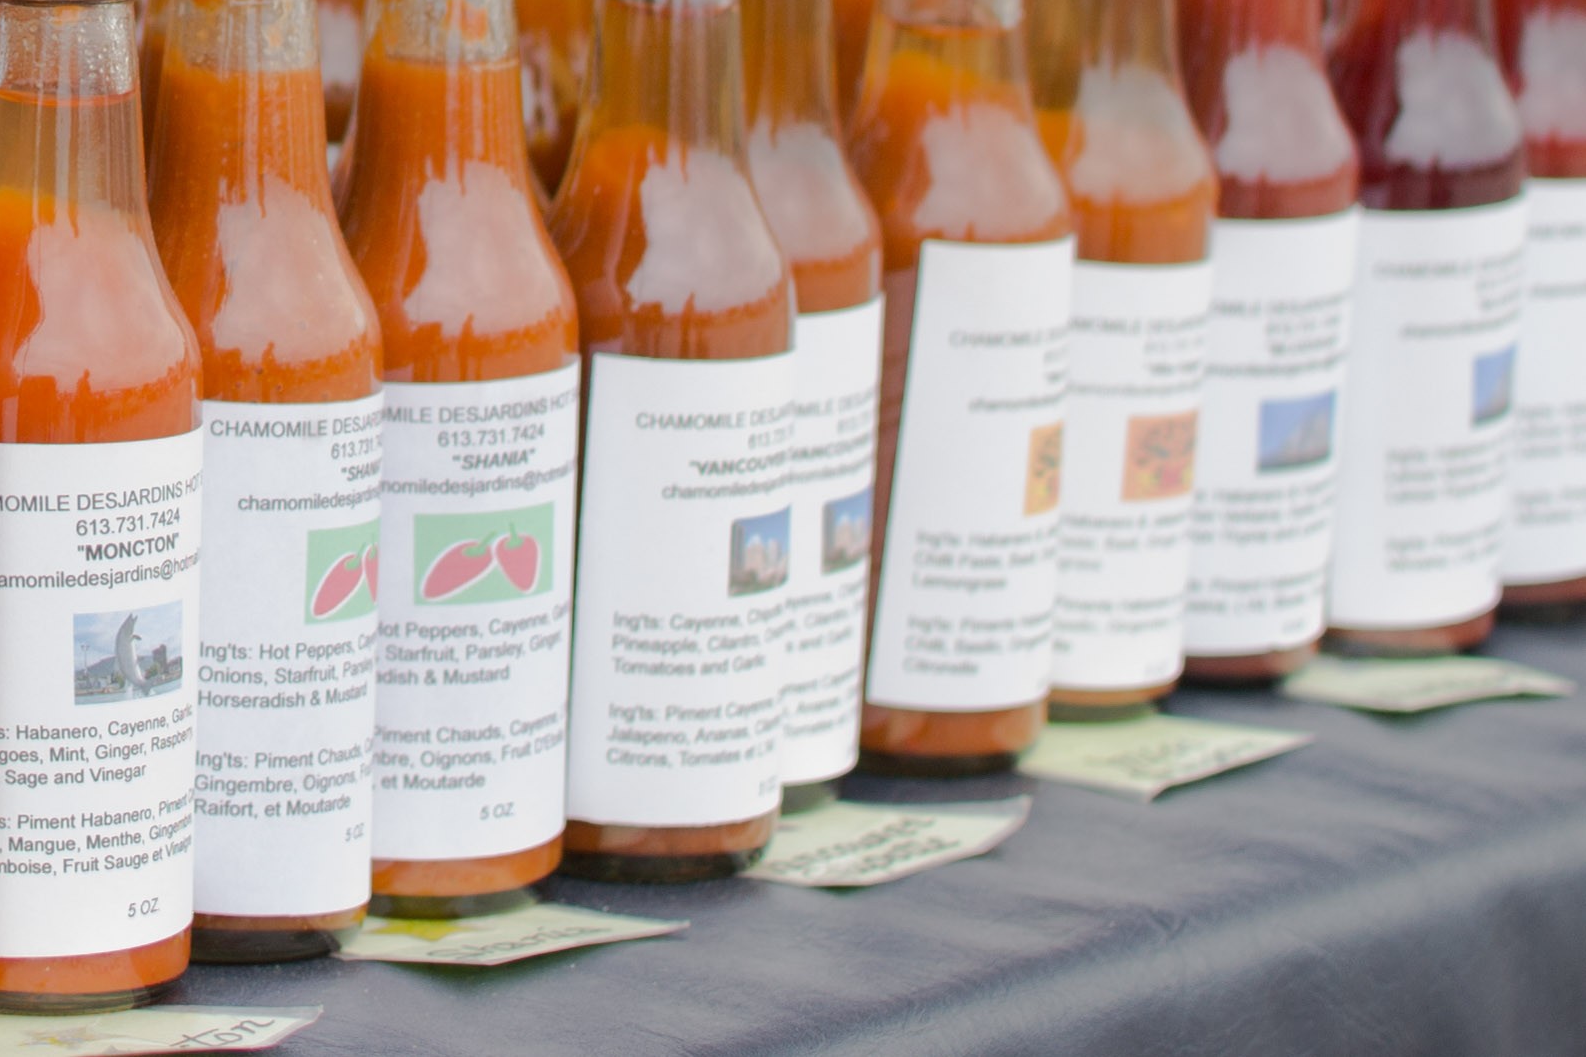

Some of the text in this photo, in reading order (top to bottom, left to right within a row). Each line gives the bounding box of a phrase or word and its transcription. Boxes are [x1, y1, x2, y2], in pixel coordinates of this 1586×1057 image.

[438, 398, 548, 424] DESJARDINS
[635, 411, 745, 432] CHAMOMILE
[210, 419, 328, 438] CHAMOMILE
[437, 423, 545, 448] 613.731.7424
[452, 448, 537, 471] "SHANIA"
[76, 480, 183, 511] DESJARDINS
[75, 507, 181, 537] 613.731.7424
[77, 532, 180, 561] "MONCTON"
[405, 622, 483, 641] Peppers,
[199, 639, 355, 662] Ing'ts: Hot Peppers,
[385, 644, 460, 663] Starfruit,
[198, 665, 339, 686] Onions, Starfruit,
[423, 669, 437, 686] &
[443, 665, 511, 686] Mustard
[612, 656, 729, 676] Tomatoes and
[197, 690, 305, 708] Horseradish
[309, 690, 321, 706] &
[664, 704, 722, 722] Piment
[16, 724, 103, 740] Habanero,
[107, 715, 169, 737] Cayenne,
[436, 724, 505, 744] Chauds,
[49, 747, 90, 763] Mint,
[94, 742, 148, 761] Ginger,
[195, 750, 314, 771] Ing'ts: Piment
[420, 750, 497, 771] Oignons,
[4, 770, 49, 788] Sage
[53, 769, 85, 784] and
[88, 764, 148, 784] Vinegar
[194, 774, 298, 796] Gingembre,
[381, 772, 486, 790] et Moutarde
[194, 794, 351, 819] Raifort, et Moutarde
[479, 805, 490, 821] 5
[17, 814, 76, 830] Piment
[81, 808, 155, 828] Habanero,
[8, 838, 82, 856] Mangue,
[86, 831, 145, 850] Menthe,
[62, 856, 100, 873] Fruit
[103, 852, 150, 870] Sauge
[152, 848, 164, 862] et
[127, 902, 137, 918] 5
